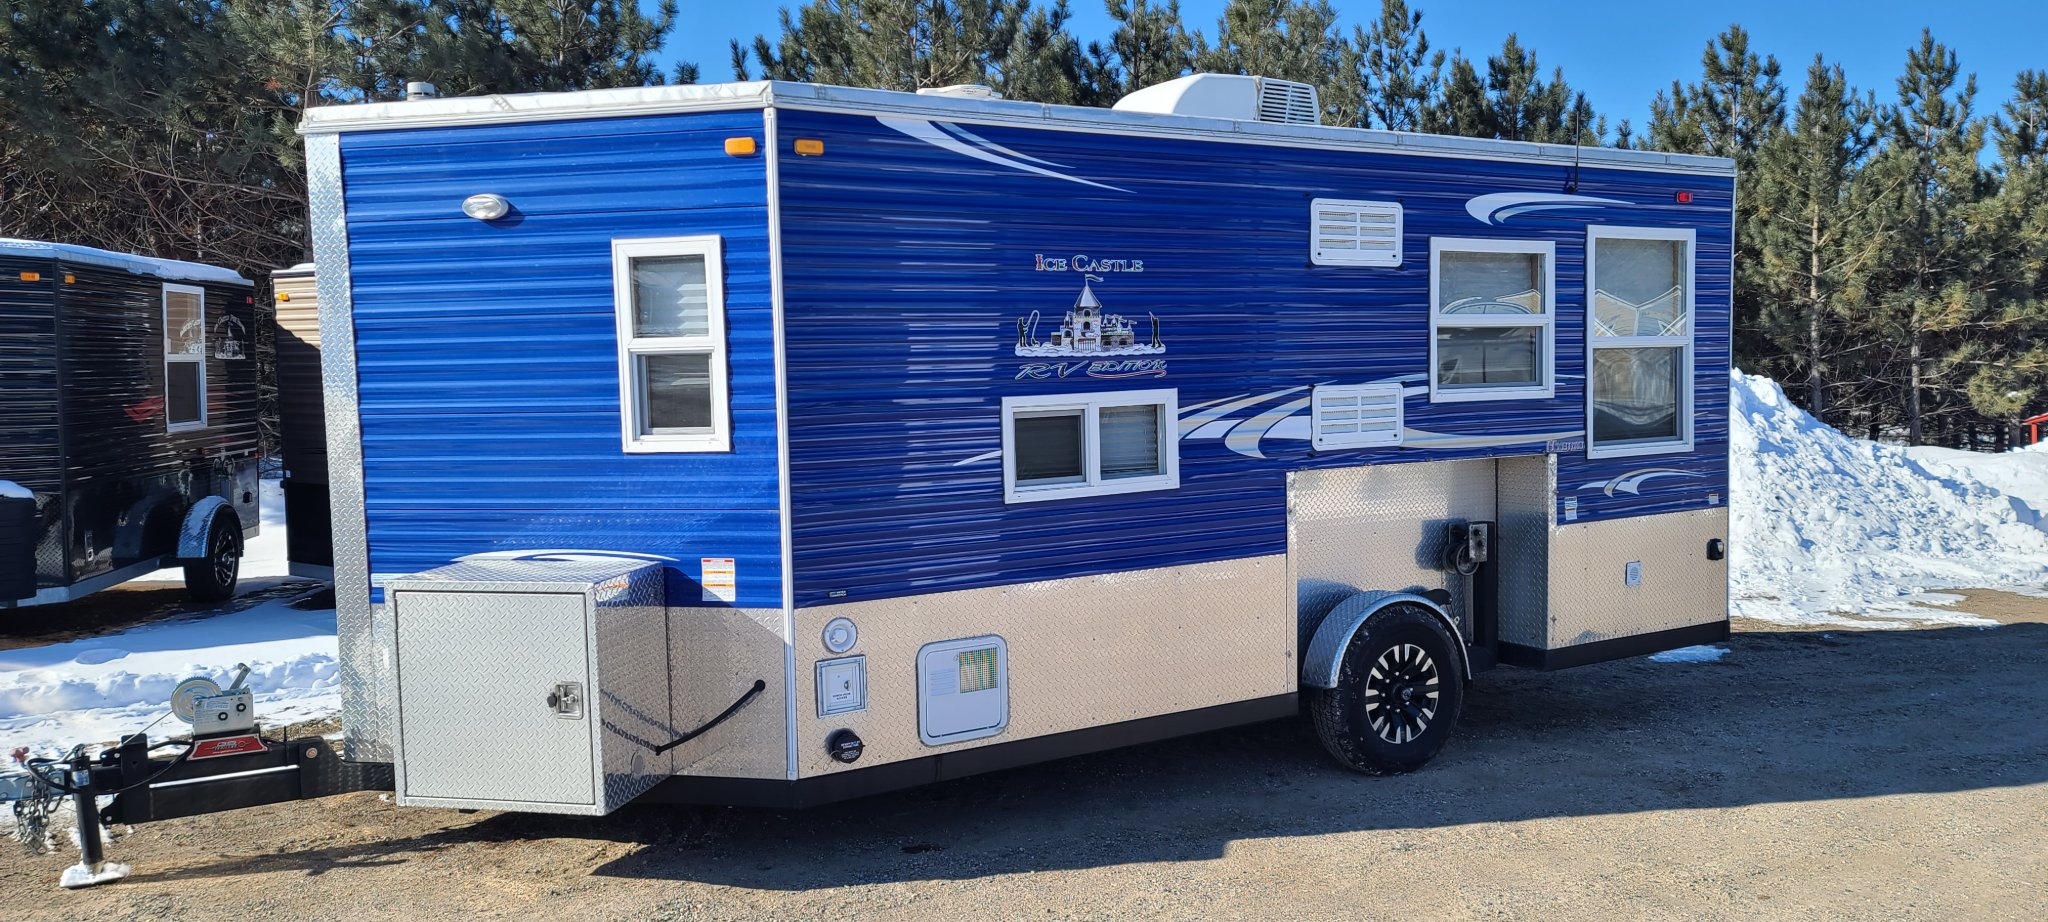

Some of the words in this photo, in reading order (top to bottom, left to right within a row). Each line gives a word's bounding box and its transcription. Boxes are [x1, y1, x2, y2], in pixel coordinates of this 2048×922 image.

[1034, 253, 1067, 271] ICE
[1071, 254, 1144, 272] CASTLE
[1015, 360, 1089, 380] RV
[1086, 359, 1167, 377] EDITION
